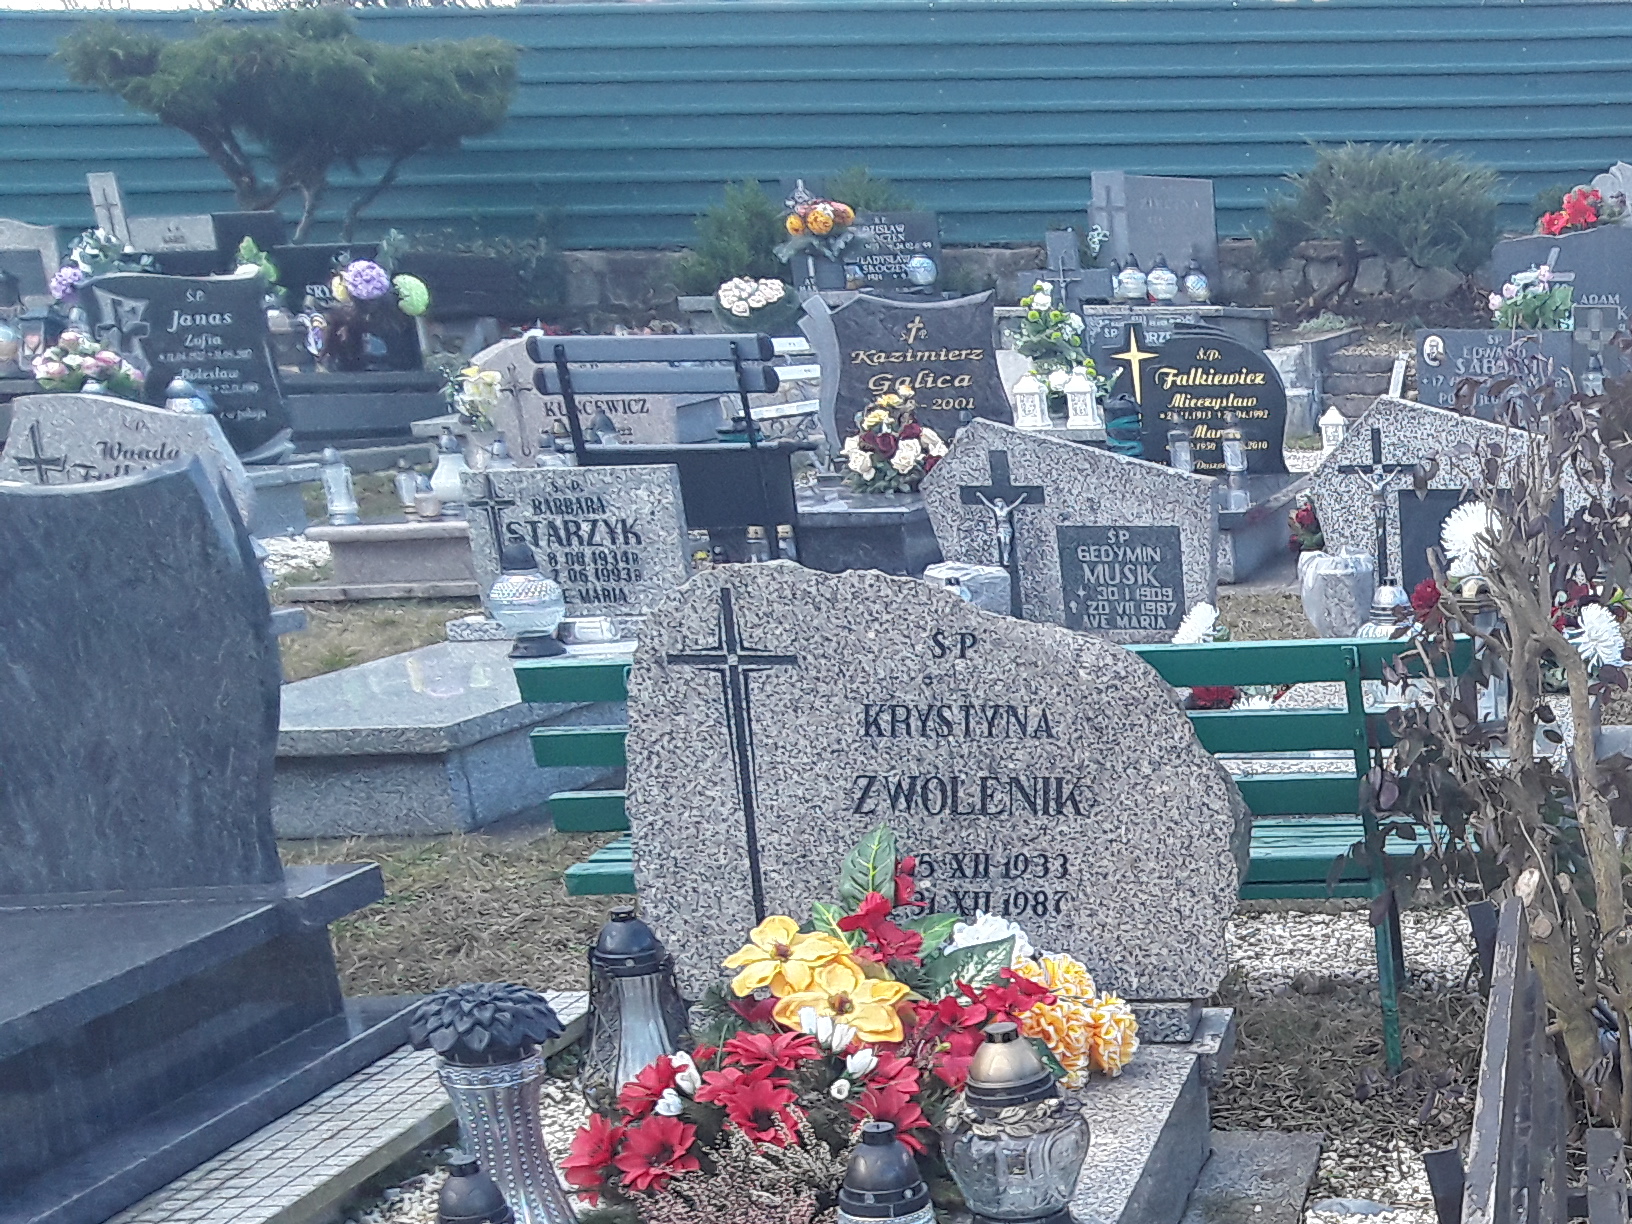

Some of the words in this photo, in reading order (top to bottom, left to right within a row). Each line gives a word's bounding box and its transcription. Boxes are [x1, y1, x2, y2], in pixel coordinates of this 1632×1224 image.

[1580, 294, 1620, 305] ADAM
[167, 310, 233, 333] Janas
[851, 348, 984, 366] Kazimierz
[868, 369, 973, 395] Galica
[1155, 366, 1266, 391] Falkiewicz
[932, 398, 976, 410] 2001
[531, 497, 607, 516] BARBARA
[506, 517, 643, 548] STARZYK
[1077, 545, 1160, 562] GEDYMIN
[1082, 562, 1161, 587] MUSIK
[578, 588, 629, 605] MARIA
[1097, 586, 1119, 600] 30
[1086, 601, 1110, 614] 20
[1114, 601, 1136, 615] VII
[1141, 601, 1178, 616] 1987
[1083, 614, 1110, 629] AVE
[1116, 614, 1167, 629] MARIA
[862, 702, 1059, 739] KRYSTYNA
[853, 774, 1091, 818] ZWOLENIK
[950, 851, 991, 879] XII
[1001, 851, 1069, 879] 1933
[951, 889, 992, 917] XII
[1002, 889, 1069, 917] 1987
